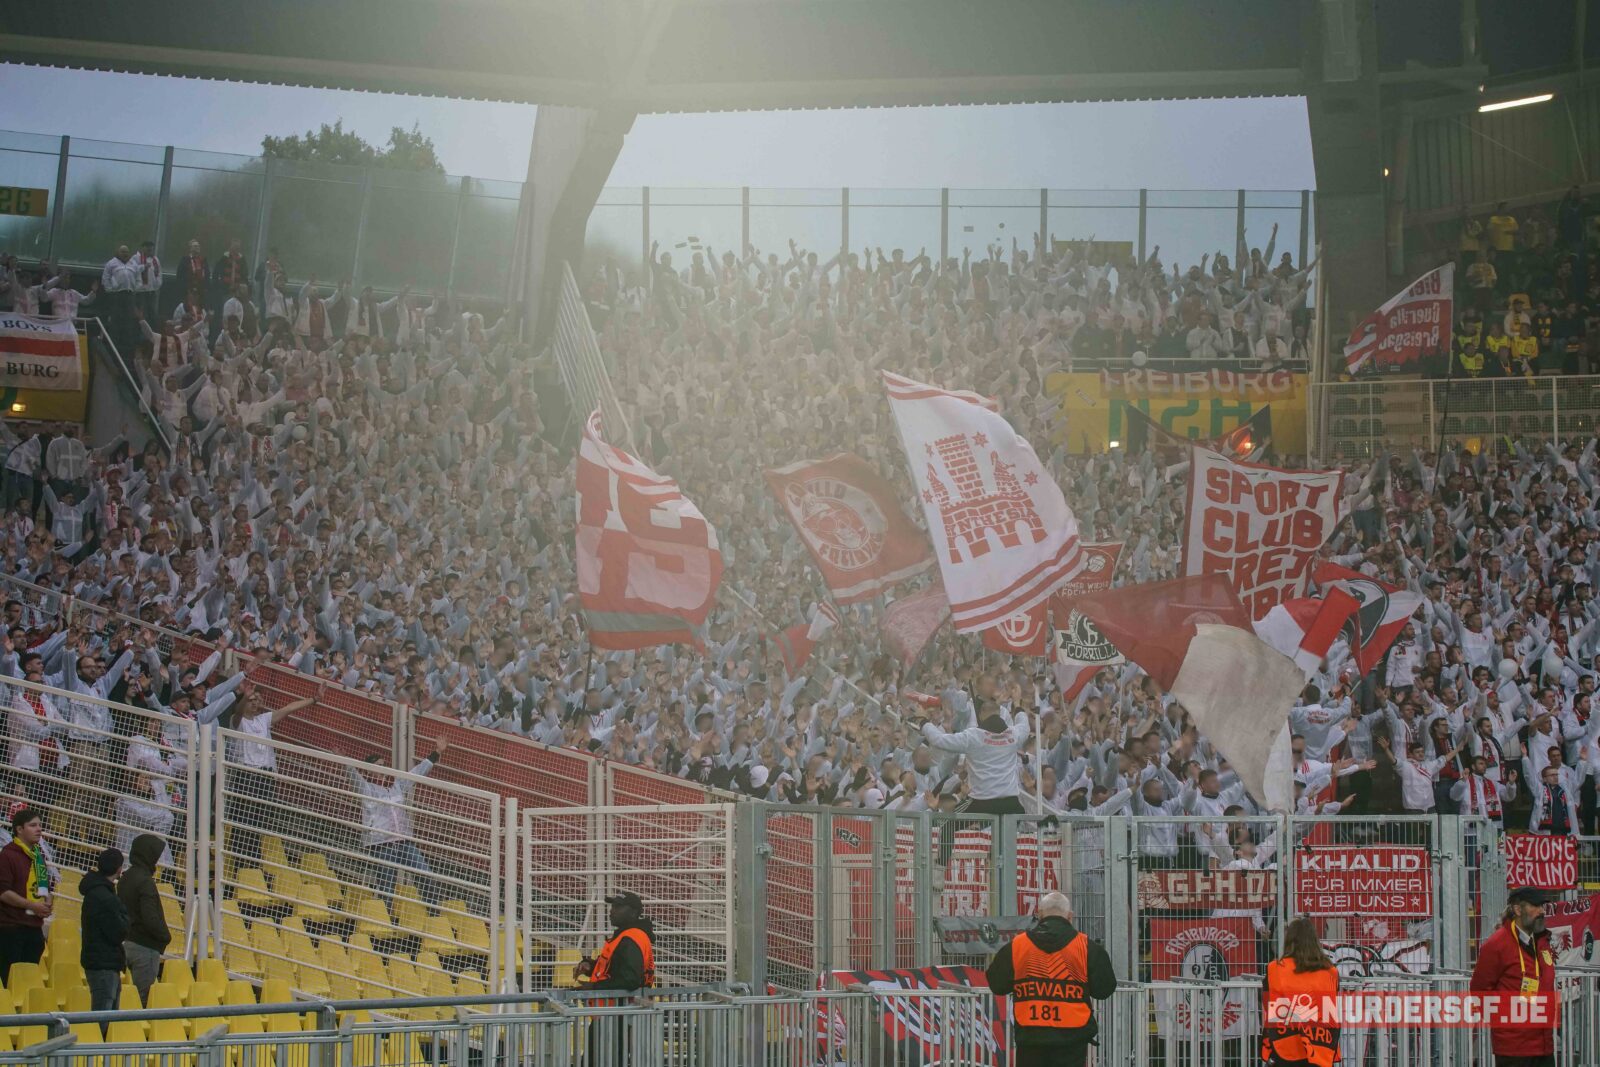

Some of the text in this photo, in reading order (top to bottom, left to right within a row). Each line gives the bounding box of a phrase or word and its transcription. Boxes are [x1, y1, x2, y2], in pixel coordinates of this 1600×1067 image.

[3, 319, 53, 333] BOYS
[6, 361, 60, 378] BURG
[1101, 366, 1291, 395] FREIBURG
[1205, 467, 1330, 516] SPORT
[1203, 506, 1323, 553] CLUB
[1505, 836, 1575, 861] SEZIONE
[1301, 854, 1421, 872] KHALID
[1505, 861, 1576, 886] BERLINO
[1301, 875, 1422, 891] FÜR IMMER
[1318, 895, 1406, 907] BEI UNS
[1165, 926, 1241, 955] FREIBURGER
[1013, 981, 1084, 999] STEWARD
[1029, 1004, 1062, 1022] 181
